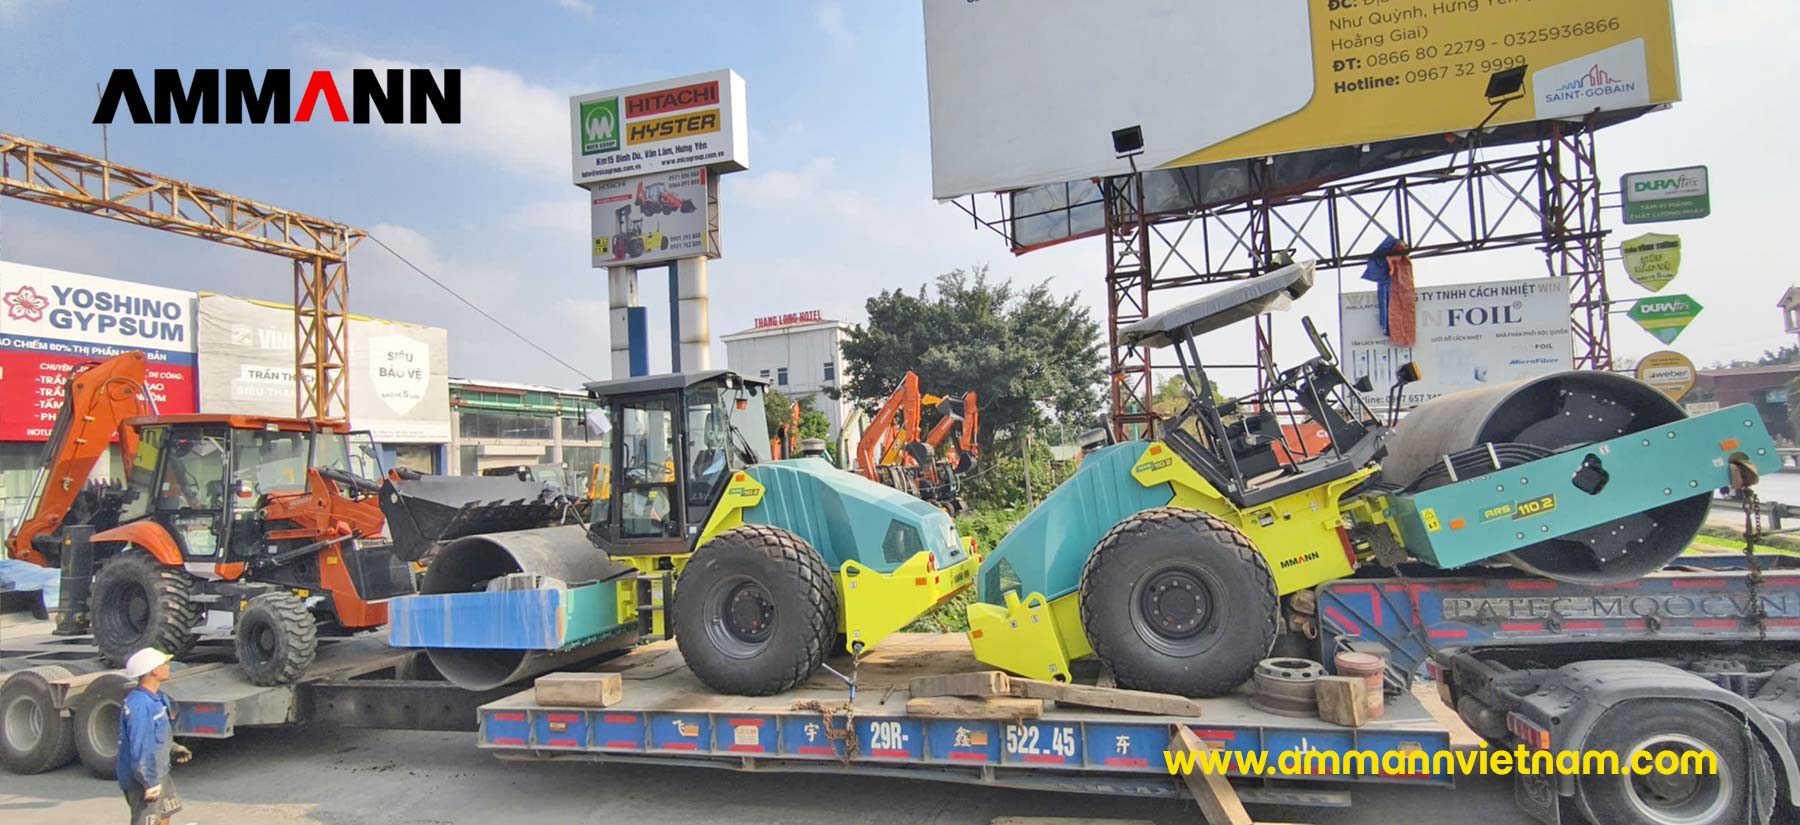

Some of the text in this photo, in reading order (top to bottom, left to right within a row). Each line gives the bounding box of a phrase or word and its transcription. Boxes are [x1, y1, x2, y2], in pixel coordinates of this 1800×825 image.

[1329, 0, 1478, 31] Như Quỳnh, Hưng
[1331, 26, 1429, 51] Hoằng Giai)
[1332, 58, 1361, 73] ĐT:
[1366, 51, 1410, 68] 0866
[1416, 46, 1438, 61] 80
[1444, 38, 1486, 57] 2279
[1503, 17, 1621, 47] 0325936866
[1333, 54, 1526, 94] Hotline: 0967 32 9999
[628, 85, 716, 114] HITACHI
[1545, 82, 1636, 104] SAINT-GOBAIN
[630, 113, 716, 141] HYSTER
[595, 154, 615, 166] Km15
[694, 140, 708, 151] Yên
[52, 285, 182, 320] YOSHINO
[1421, 291, 1435, 302] TY
[1436, 289, 1466, 300] TNHH
[1468, 284, 1500, 298] CÁCH
[1501, 283, 1536, 301] NHIỆT
[1537, 282, 1561, 293] WIN
[49, 308, 184, 342] GYPSUM
[799, 309, 822, 321] HOTEL
[49, 343, 72, 352] 80%
[1484, 497, 1554, 519] ARS 110.2
[804, 722, 820, 743] 宇
[870, 721, 909, 750] 29R-
[953, 726, 972, 748] 鑫
[1115, 735, 1131, 755] 东
